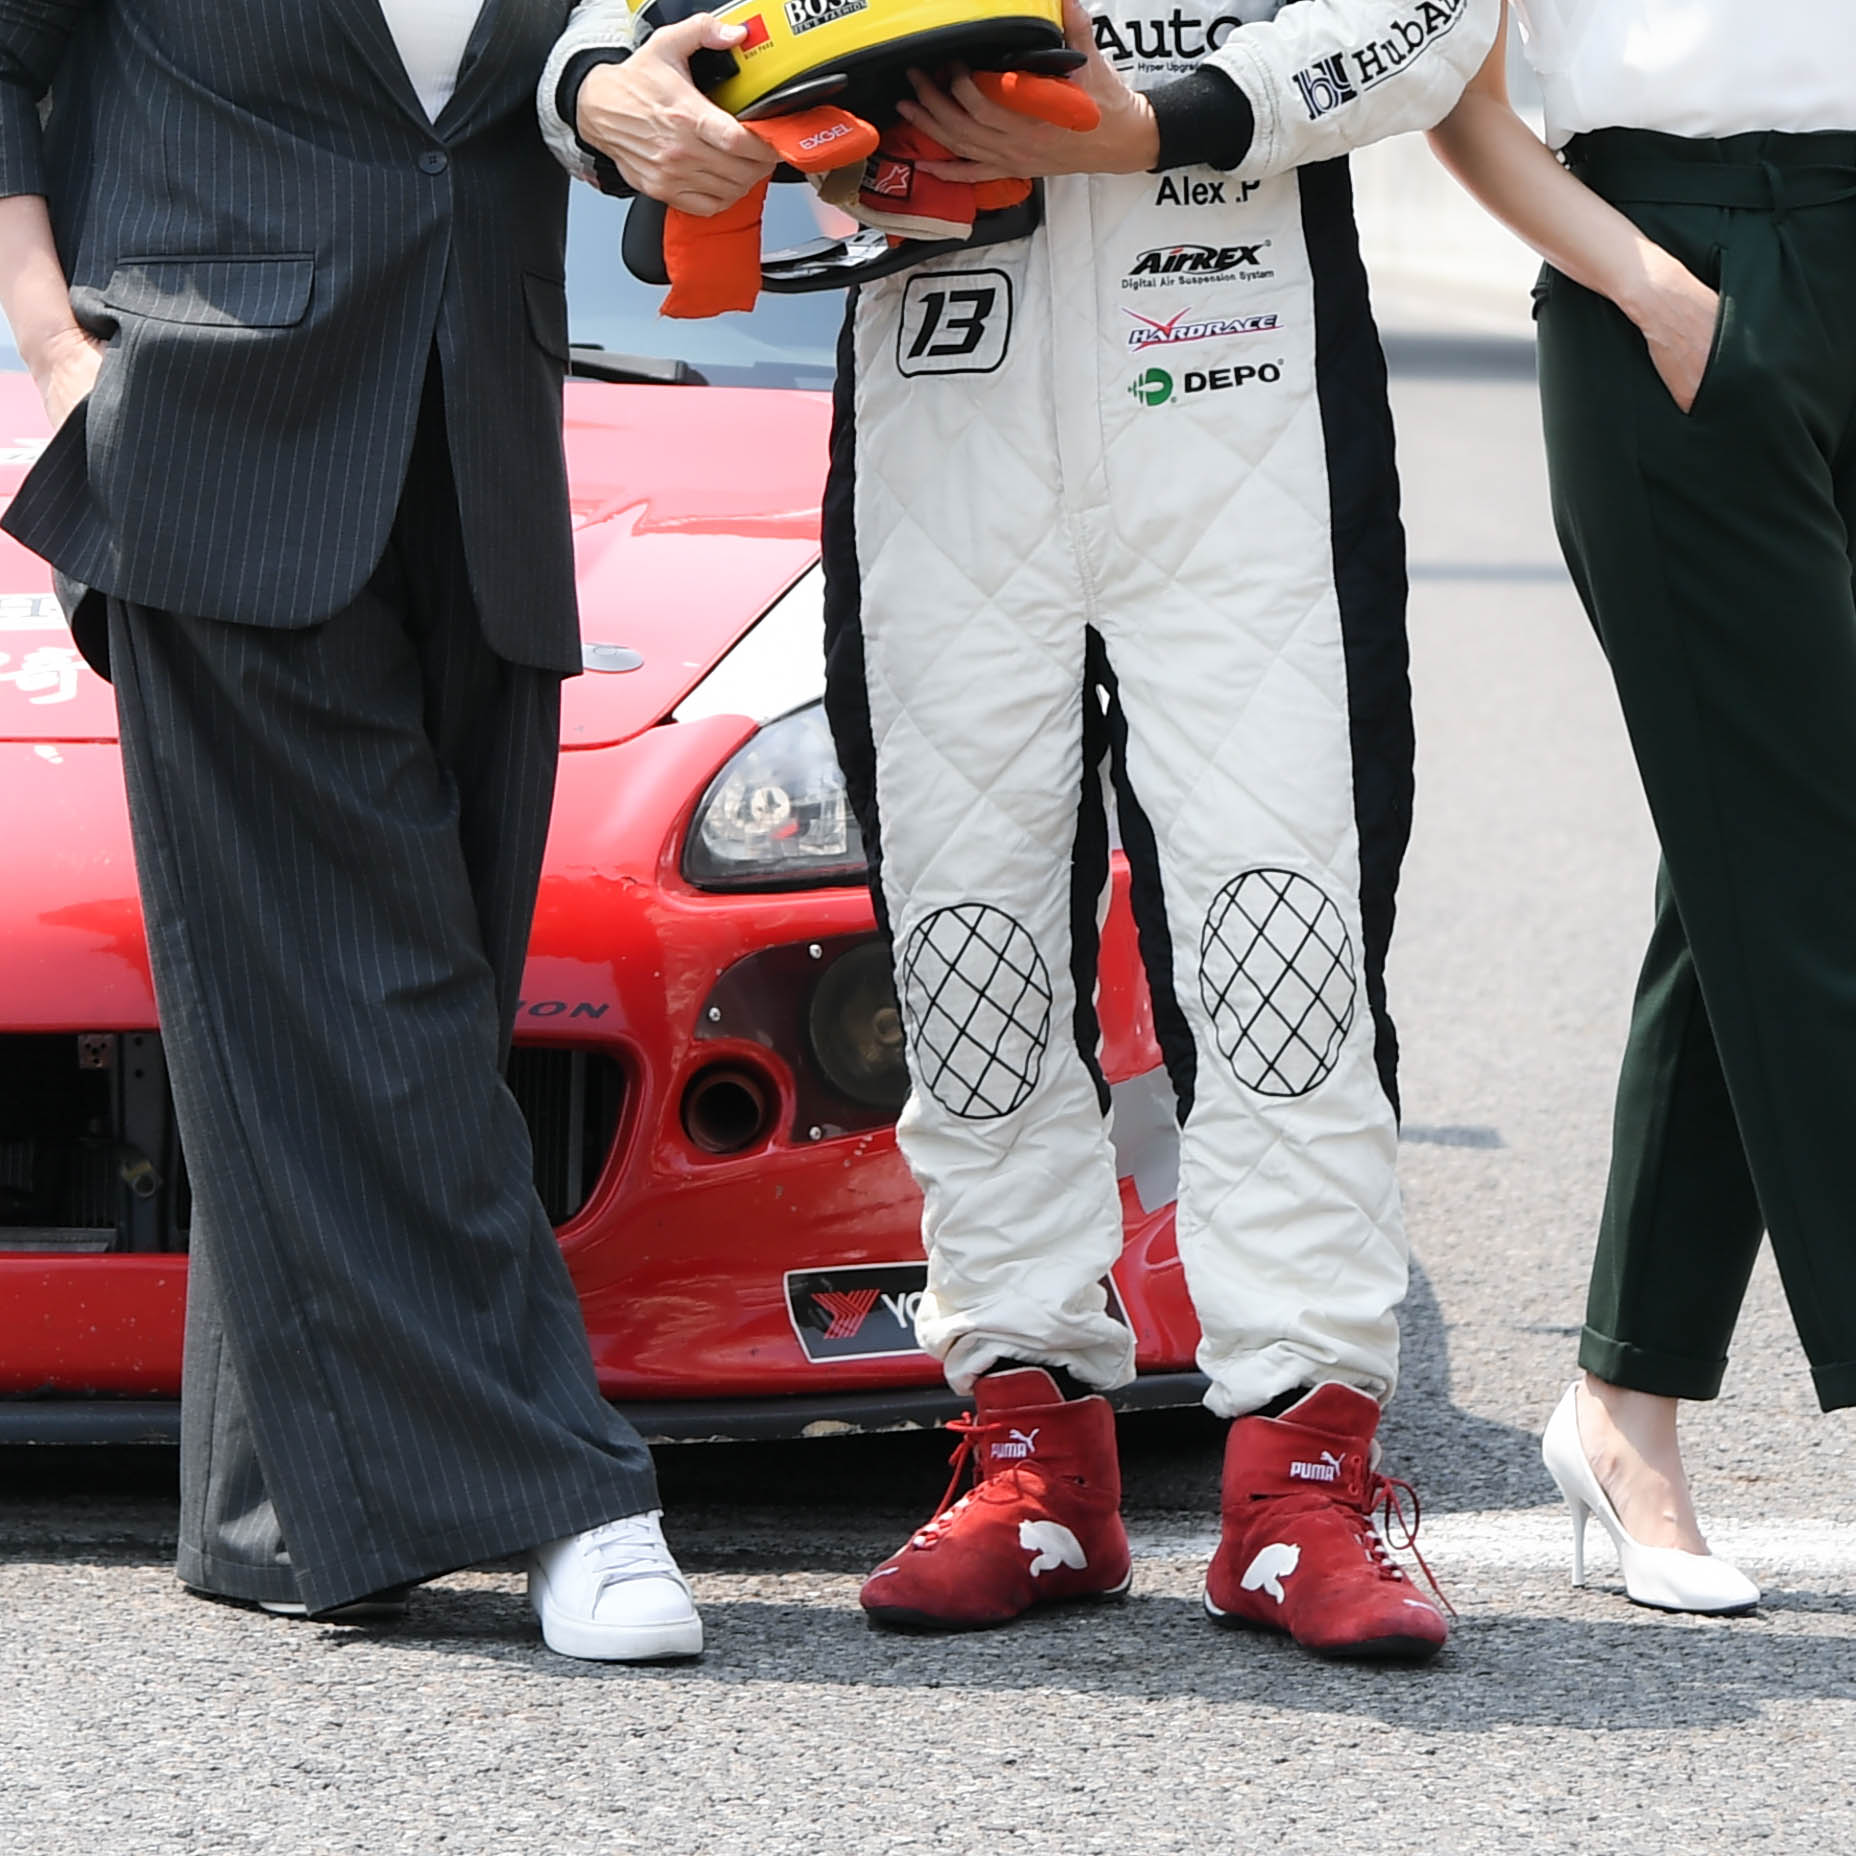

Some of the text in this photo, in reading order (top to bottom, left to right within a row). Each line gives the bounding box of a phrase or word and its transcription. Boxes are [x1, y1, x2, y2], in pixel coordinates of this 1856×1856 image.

[800, 123, 852, 151] EXGEL
[1155, 175, 1226, 206] Alex
[1121, 269, 1275, 291] Digital Air Suspension System
[907, 287, 996, 360] 13
[1128, 314, 1278, 345] HARDRACE
[1184, 363, 1281, 393] DEPO
[991, 1443, 1028, 1459] PUMA
[1290, 1461, 1335, 1482] PUMA
